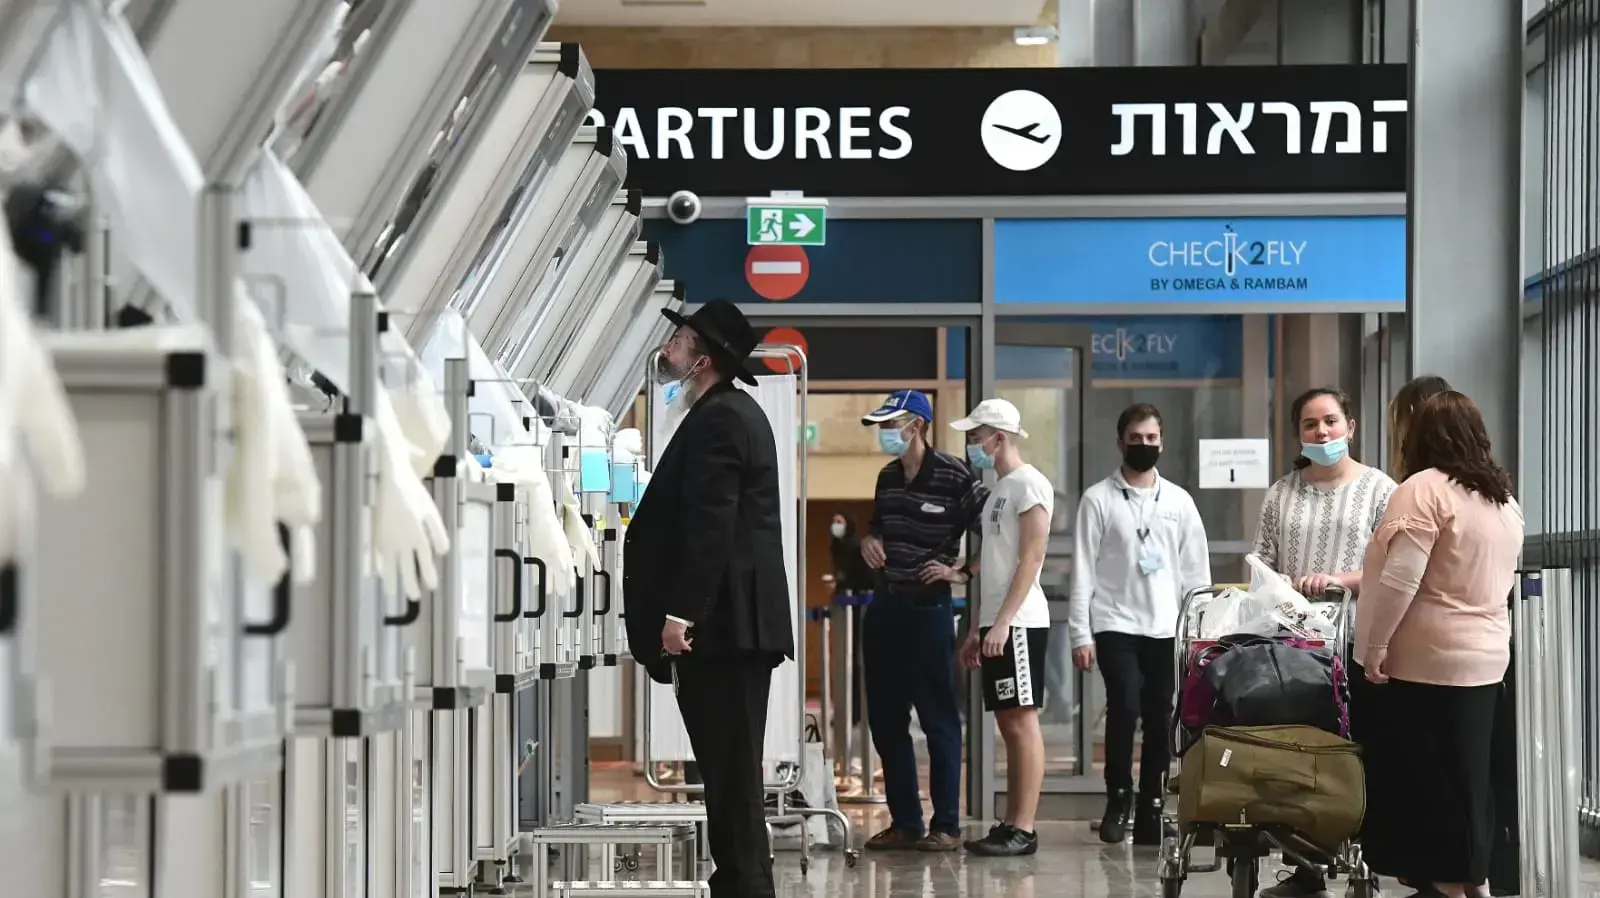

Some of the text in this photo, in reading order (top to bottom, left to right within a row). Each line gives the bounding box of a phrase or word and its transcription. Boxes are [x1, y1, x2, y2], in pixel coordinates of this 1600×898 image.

[1148, 233, 1308, 276] CHECK2FLY
[1151, 277, 1308, 291] BY OMEGA & RAMBAM
